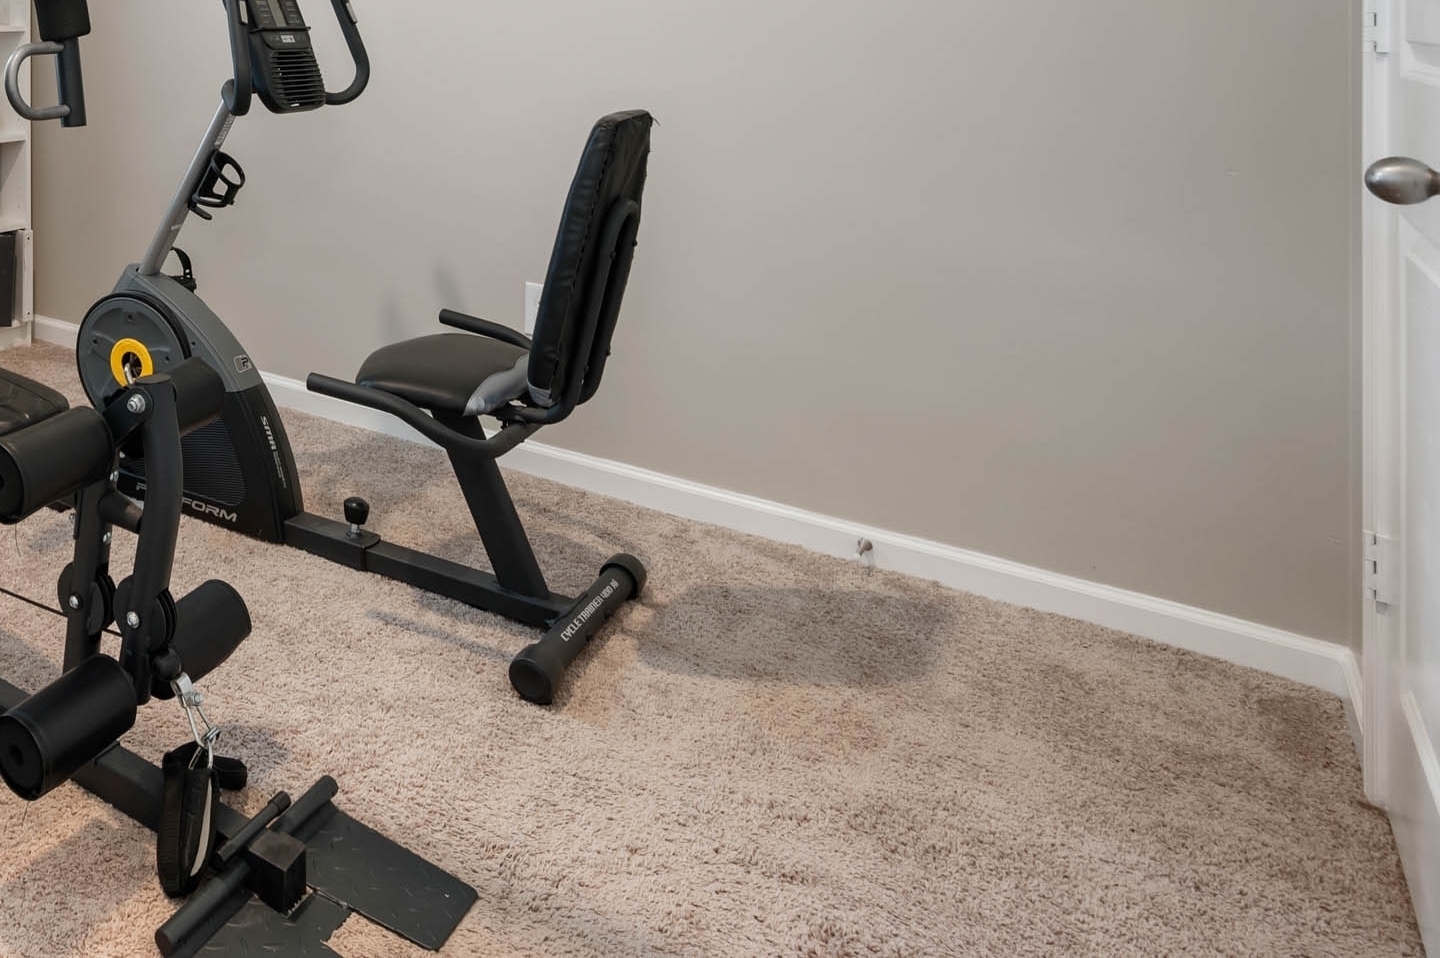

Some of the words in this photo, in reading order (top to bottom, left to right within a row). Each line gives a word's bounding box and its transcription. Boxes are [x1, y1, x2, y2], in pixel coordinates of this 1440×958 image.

[136, 482, 238, 522] PFORM
[561, 616, 584, 641] CYCLE
[579, 596, 604, 623] TRAINER
[601, 585, 614, 599] 400
